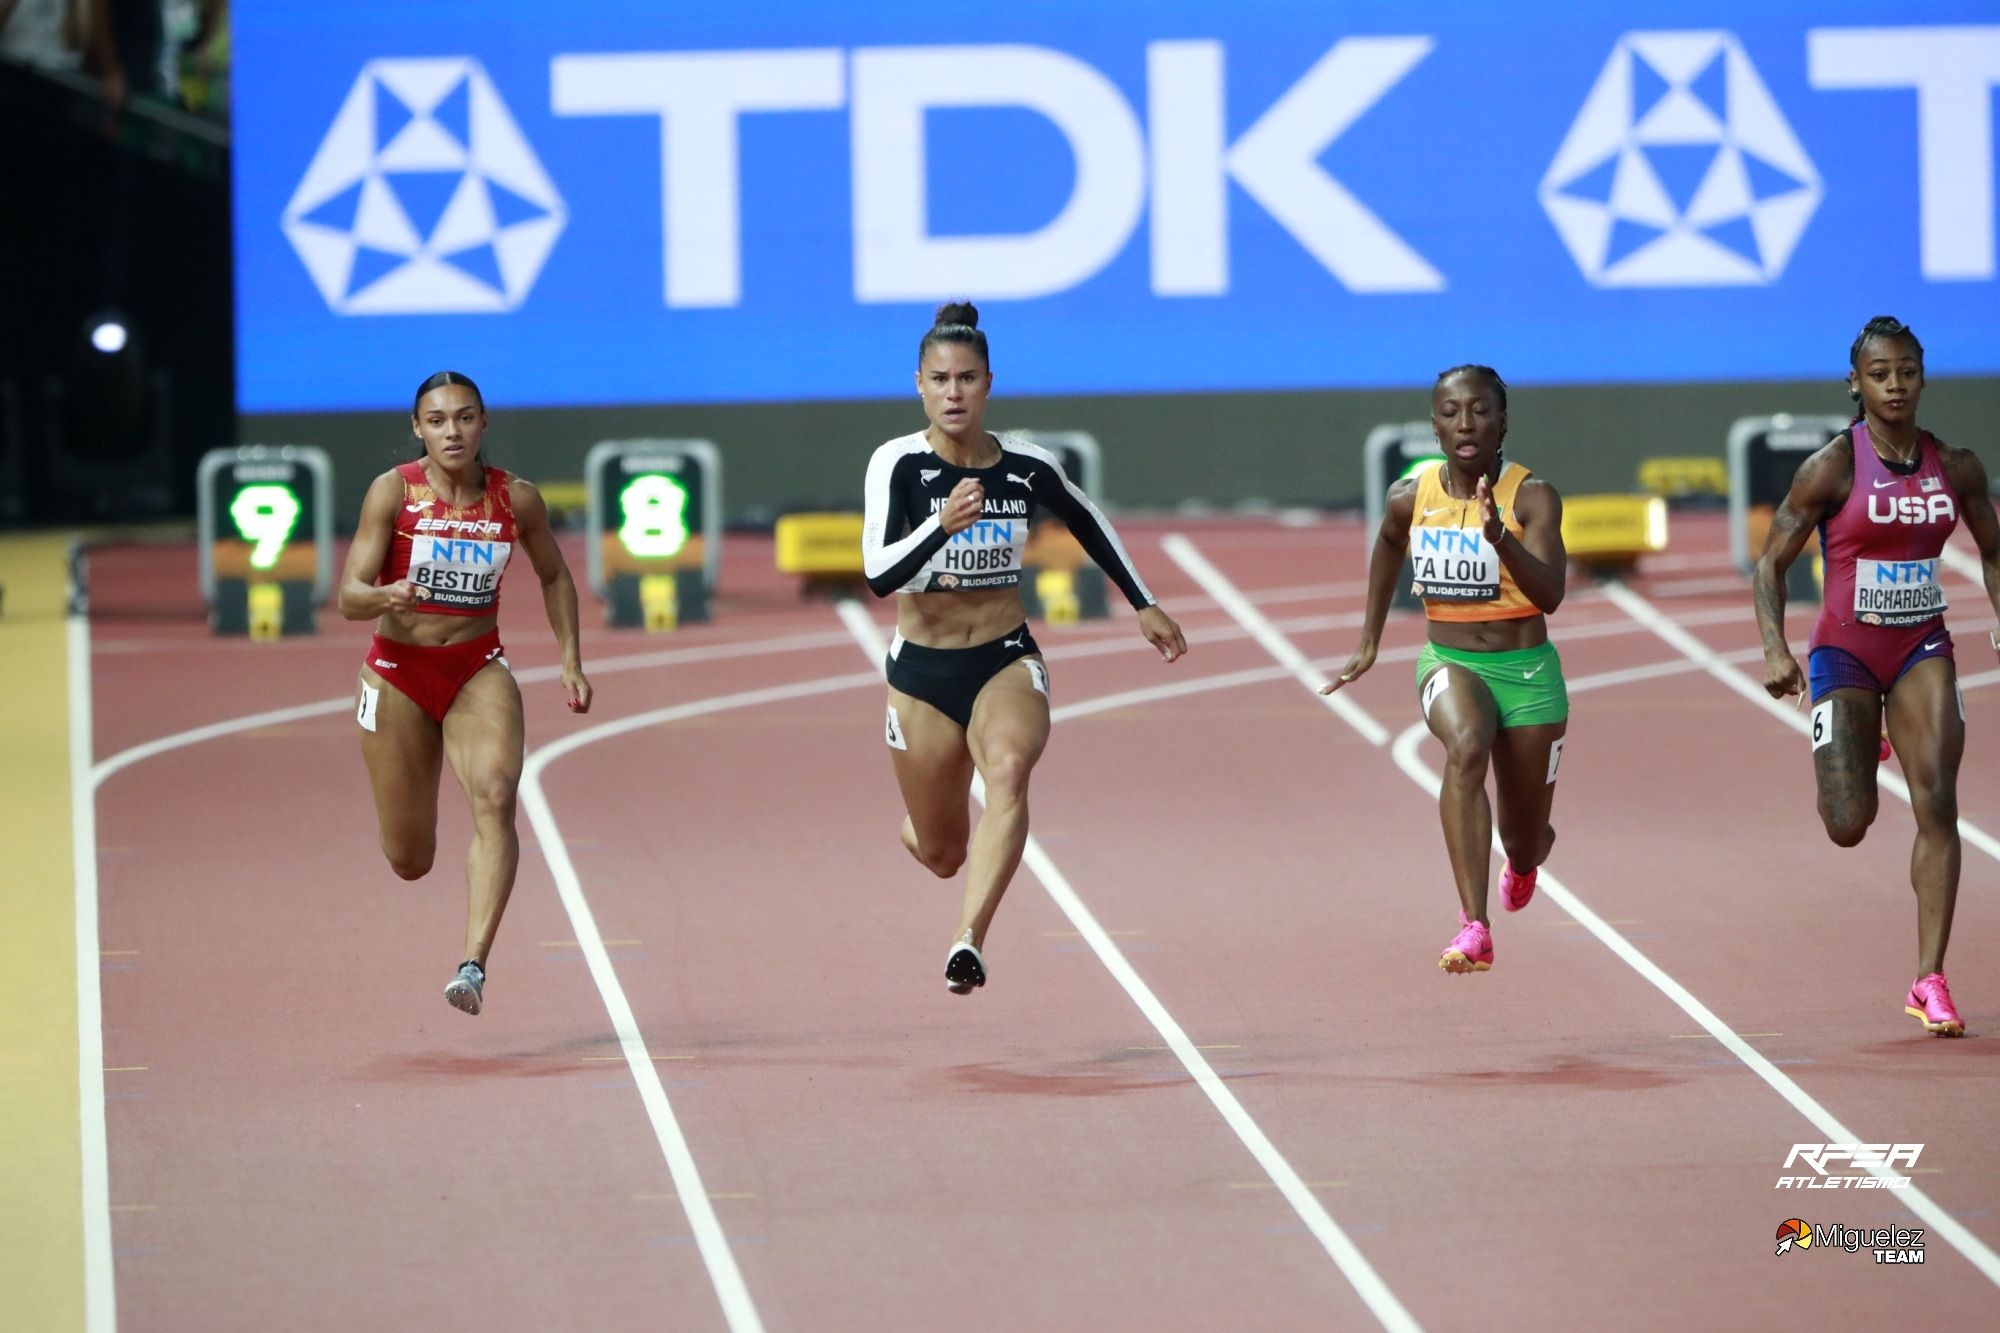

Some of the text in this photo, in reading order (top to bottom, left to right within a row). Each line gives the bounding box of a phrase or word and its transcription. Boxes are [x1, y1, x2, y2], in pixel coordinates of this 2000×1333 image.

[550, 35, 1447, 308] TDK
[618, 473, 688, 558] 8
[980, 498, 1027, 514] ALAND
[1868, 494, 1955, 524] USA
[229, 483, 302, 569] 9
[414, 518, 503, 534] ESPAÑA
[431, 538, 493, 566] NTN
[1420, 528, 1480, 556] NTN
[945, 547, 1013, 571] HOBBS
[1414, 556, 1486, 582] TA LOU
[415, 567, 496, 591] BESTUÉ
[961, 574, 1018, 587] BUDAPEST 23
[1875, 560, 1933, 584] NTN
[434, 592, 483, 605] BUDAPEST
[1427, 585, 1493, 597] BUDAPEST 23
[1859, 585, 1943, 609] RICHARDSON
[1813, 711, 1824, 743] 6
